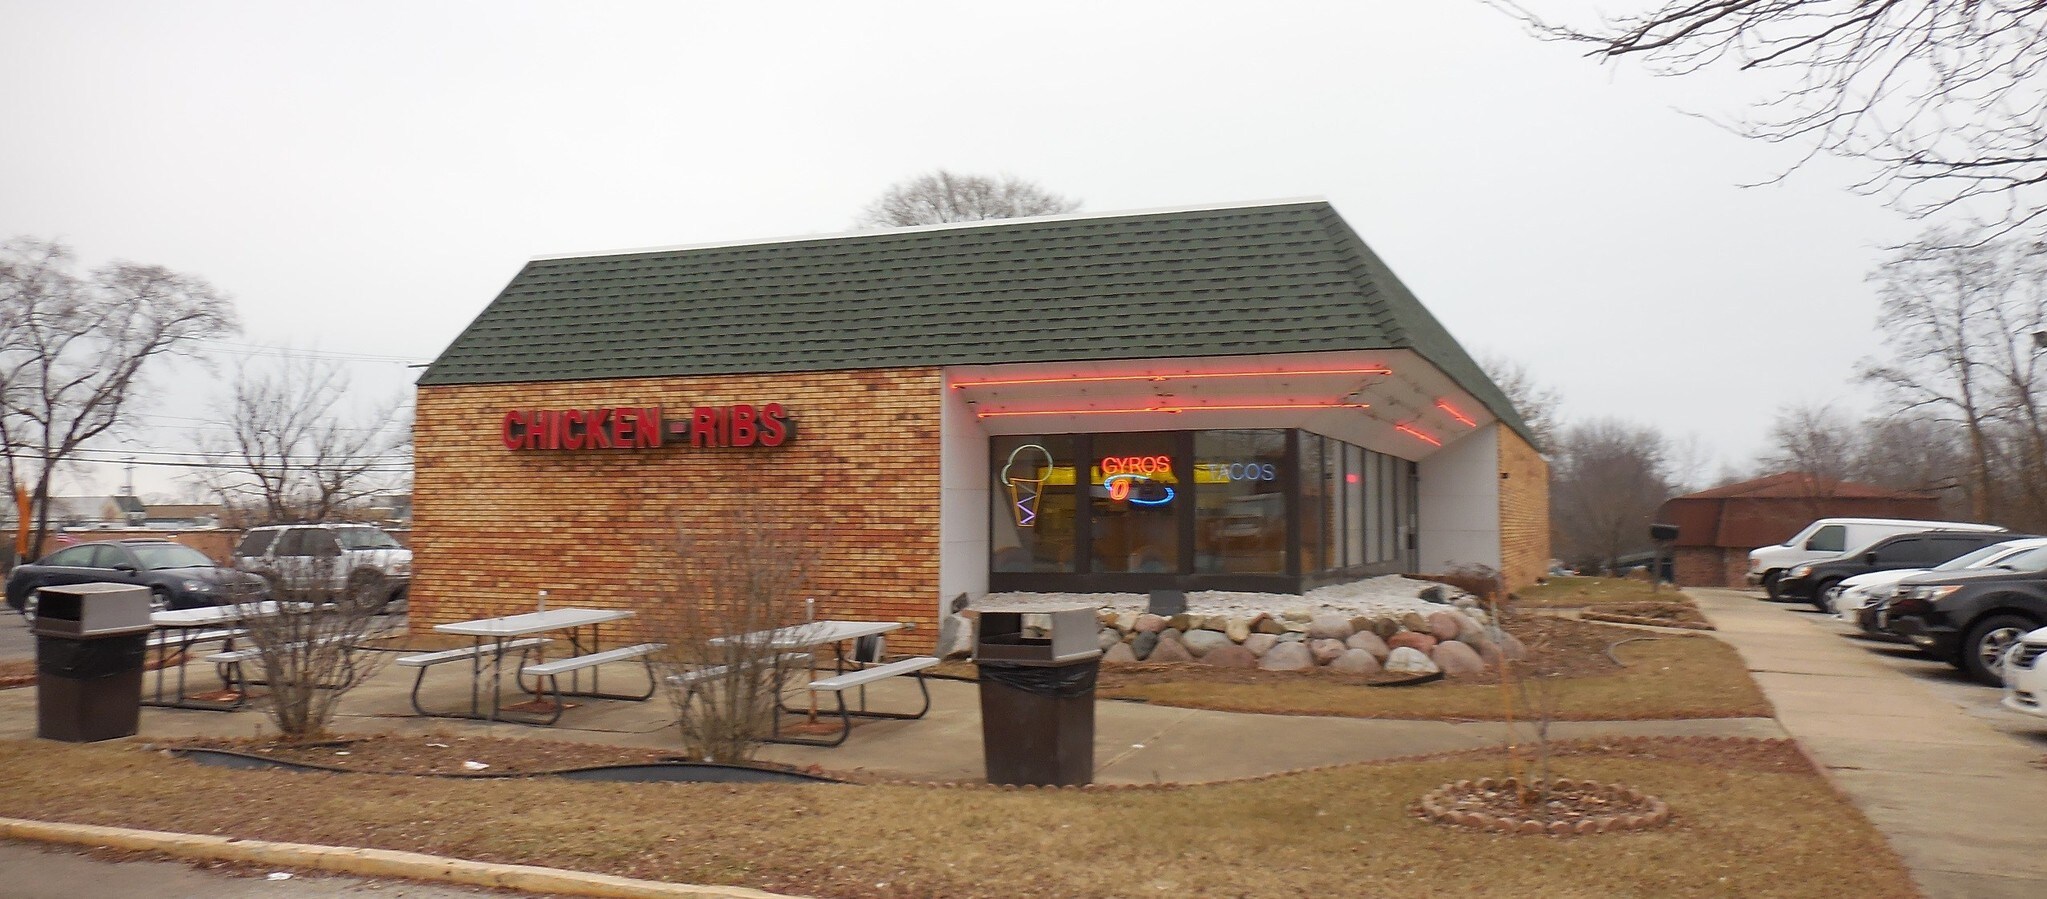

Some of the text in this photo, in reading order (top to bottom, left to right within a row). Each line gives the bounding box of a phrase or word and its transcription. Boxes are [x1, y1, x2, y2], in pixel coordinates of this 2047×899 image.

[502, 408, 663, 450] CHICKEN
[691, 402, 787, 447] RIBS
[1102, 456, 1170, 474] GYROS
[1208, 463, 1276, 481] TACOS
